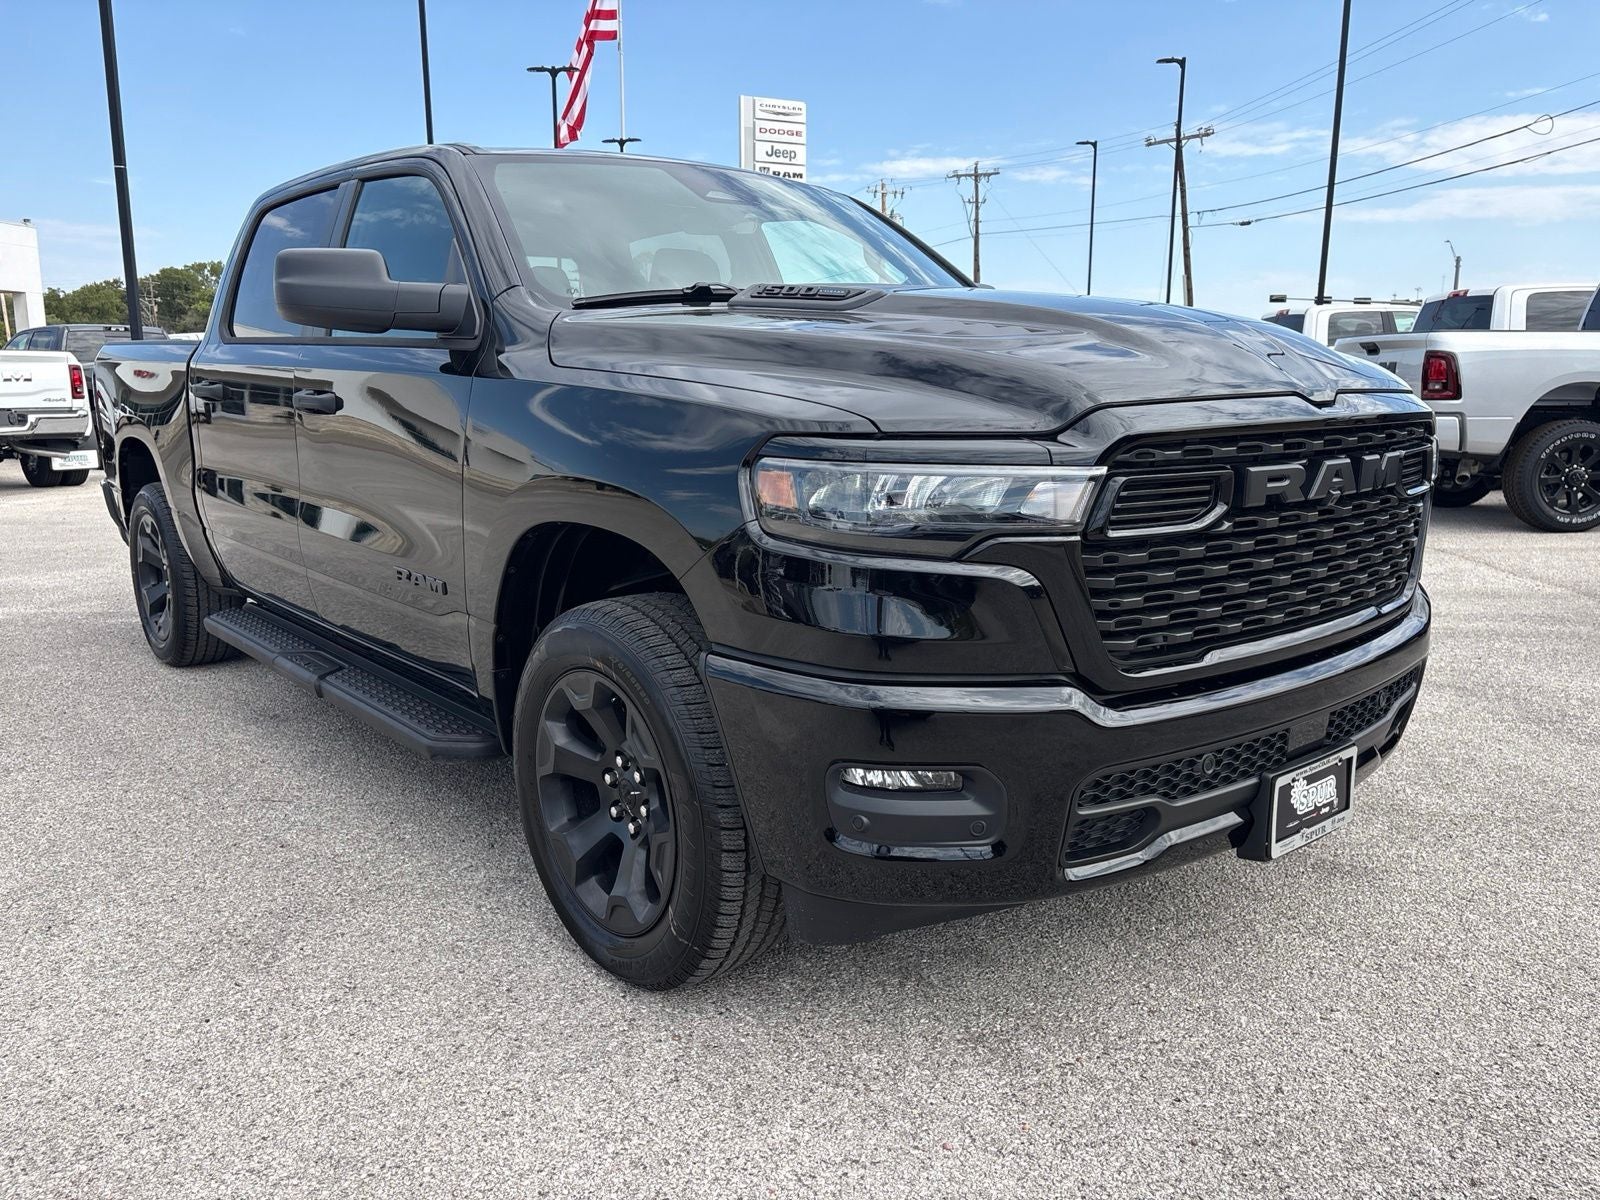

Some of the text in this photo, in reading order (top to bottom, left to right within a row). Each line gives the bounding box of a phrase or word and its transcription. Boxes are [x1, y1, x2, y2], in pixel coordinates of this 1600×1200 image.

[759, 102, 803, 111] CHRYSLER
[758, 127, 803, 137] DODGE
[765, 145, 797, 162] Jeep
[756, 283, 818, 297] 1500
[1243, 450, 1402, 508] RAM
[393, 565, 449, 596] RAM
[1297, 776, 1336, 815] SPUR
[1303, 825, 1327, 843] SPUR
